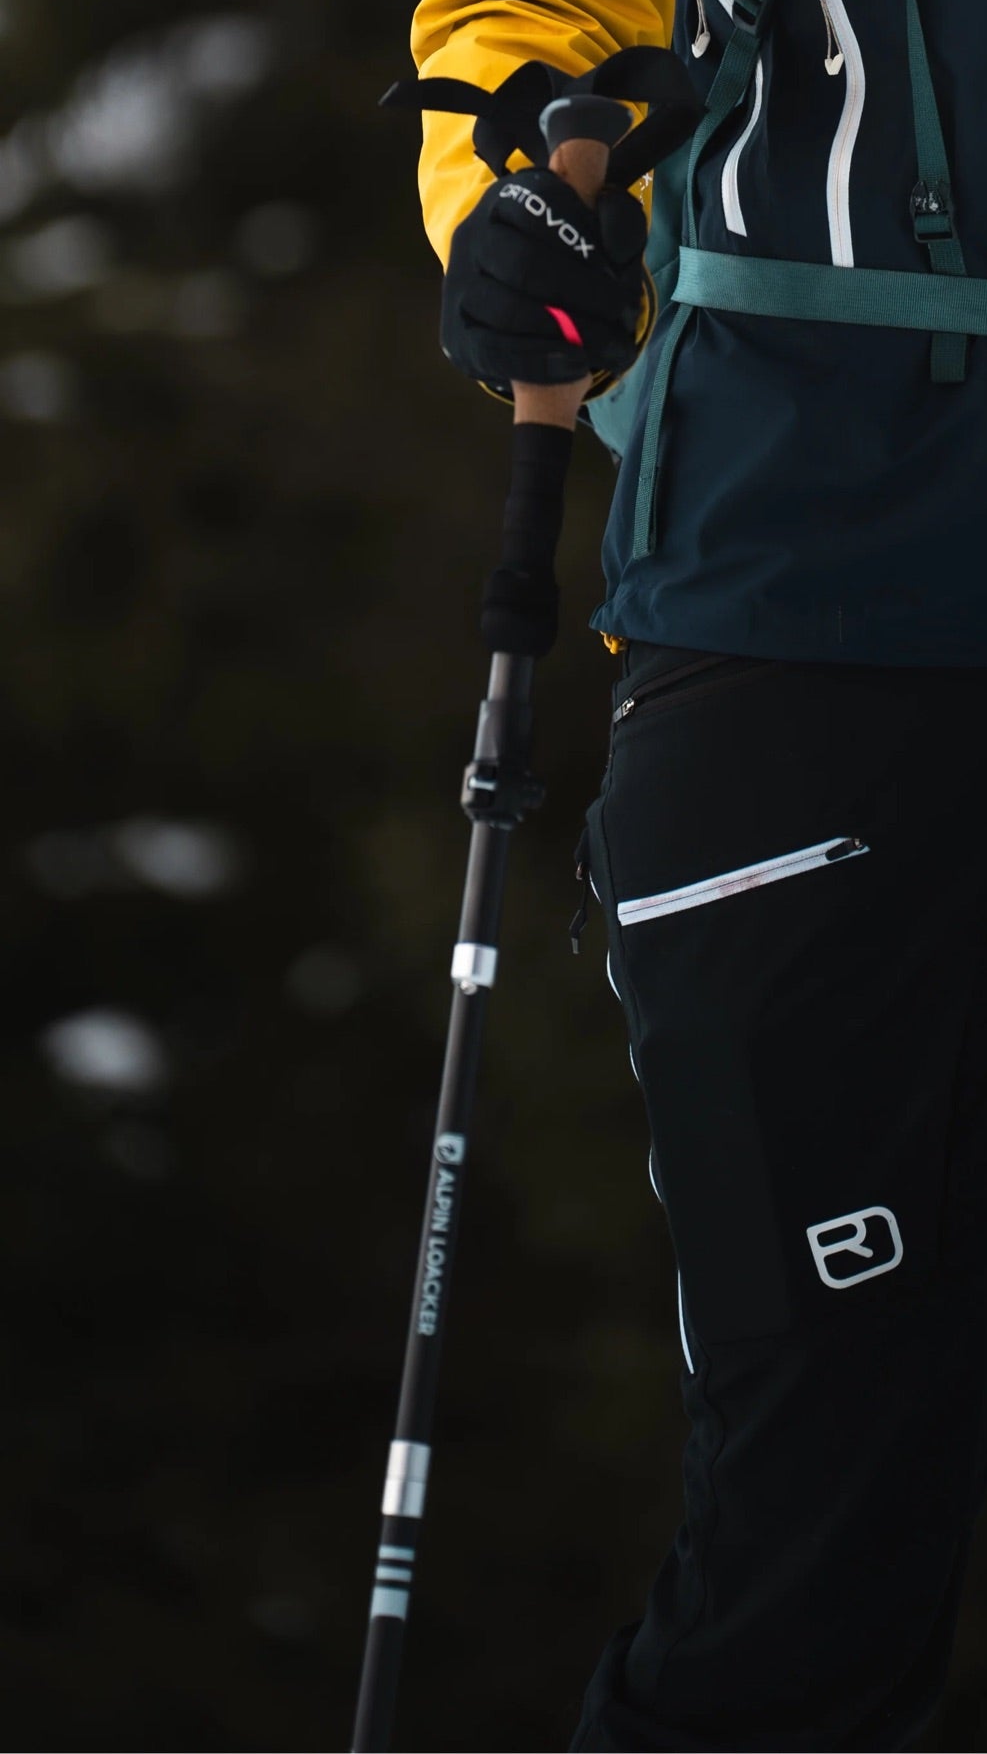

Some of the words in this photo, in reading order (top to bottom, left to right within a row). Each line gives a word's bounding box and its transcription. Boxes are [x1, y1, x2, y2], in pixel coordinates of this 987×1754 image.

[499, 183, 595, 259] ORTOVOX
[431, 1168, 454, 1232] ALPIN
[418, 1237, 446, 1336] LOACKER
